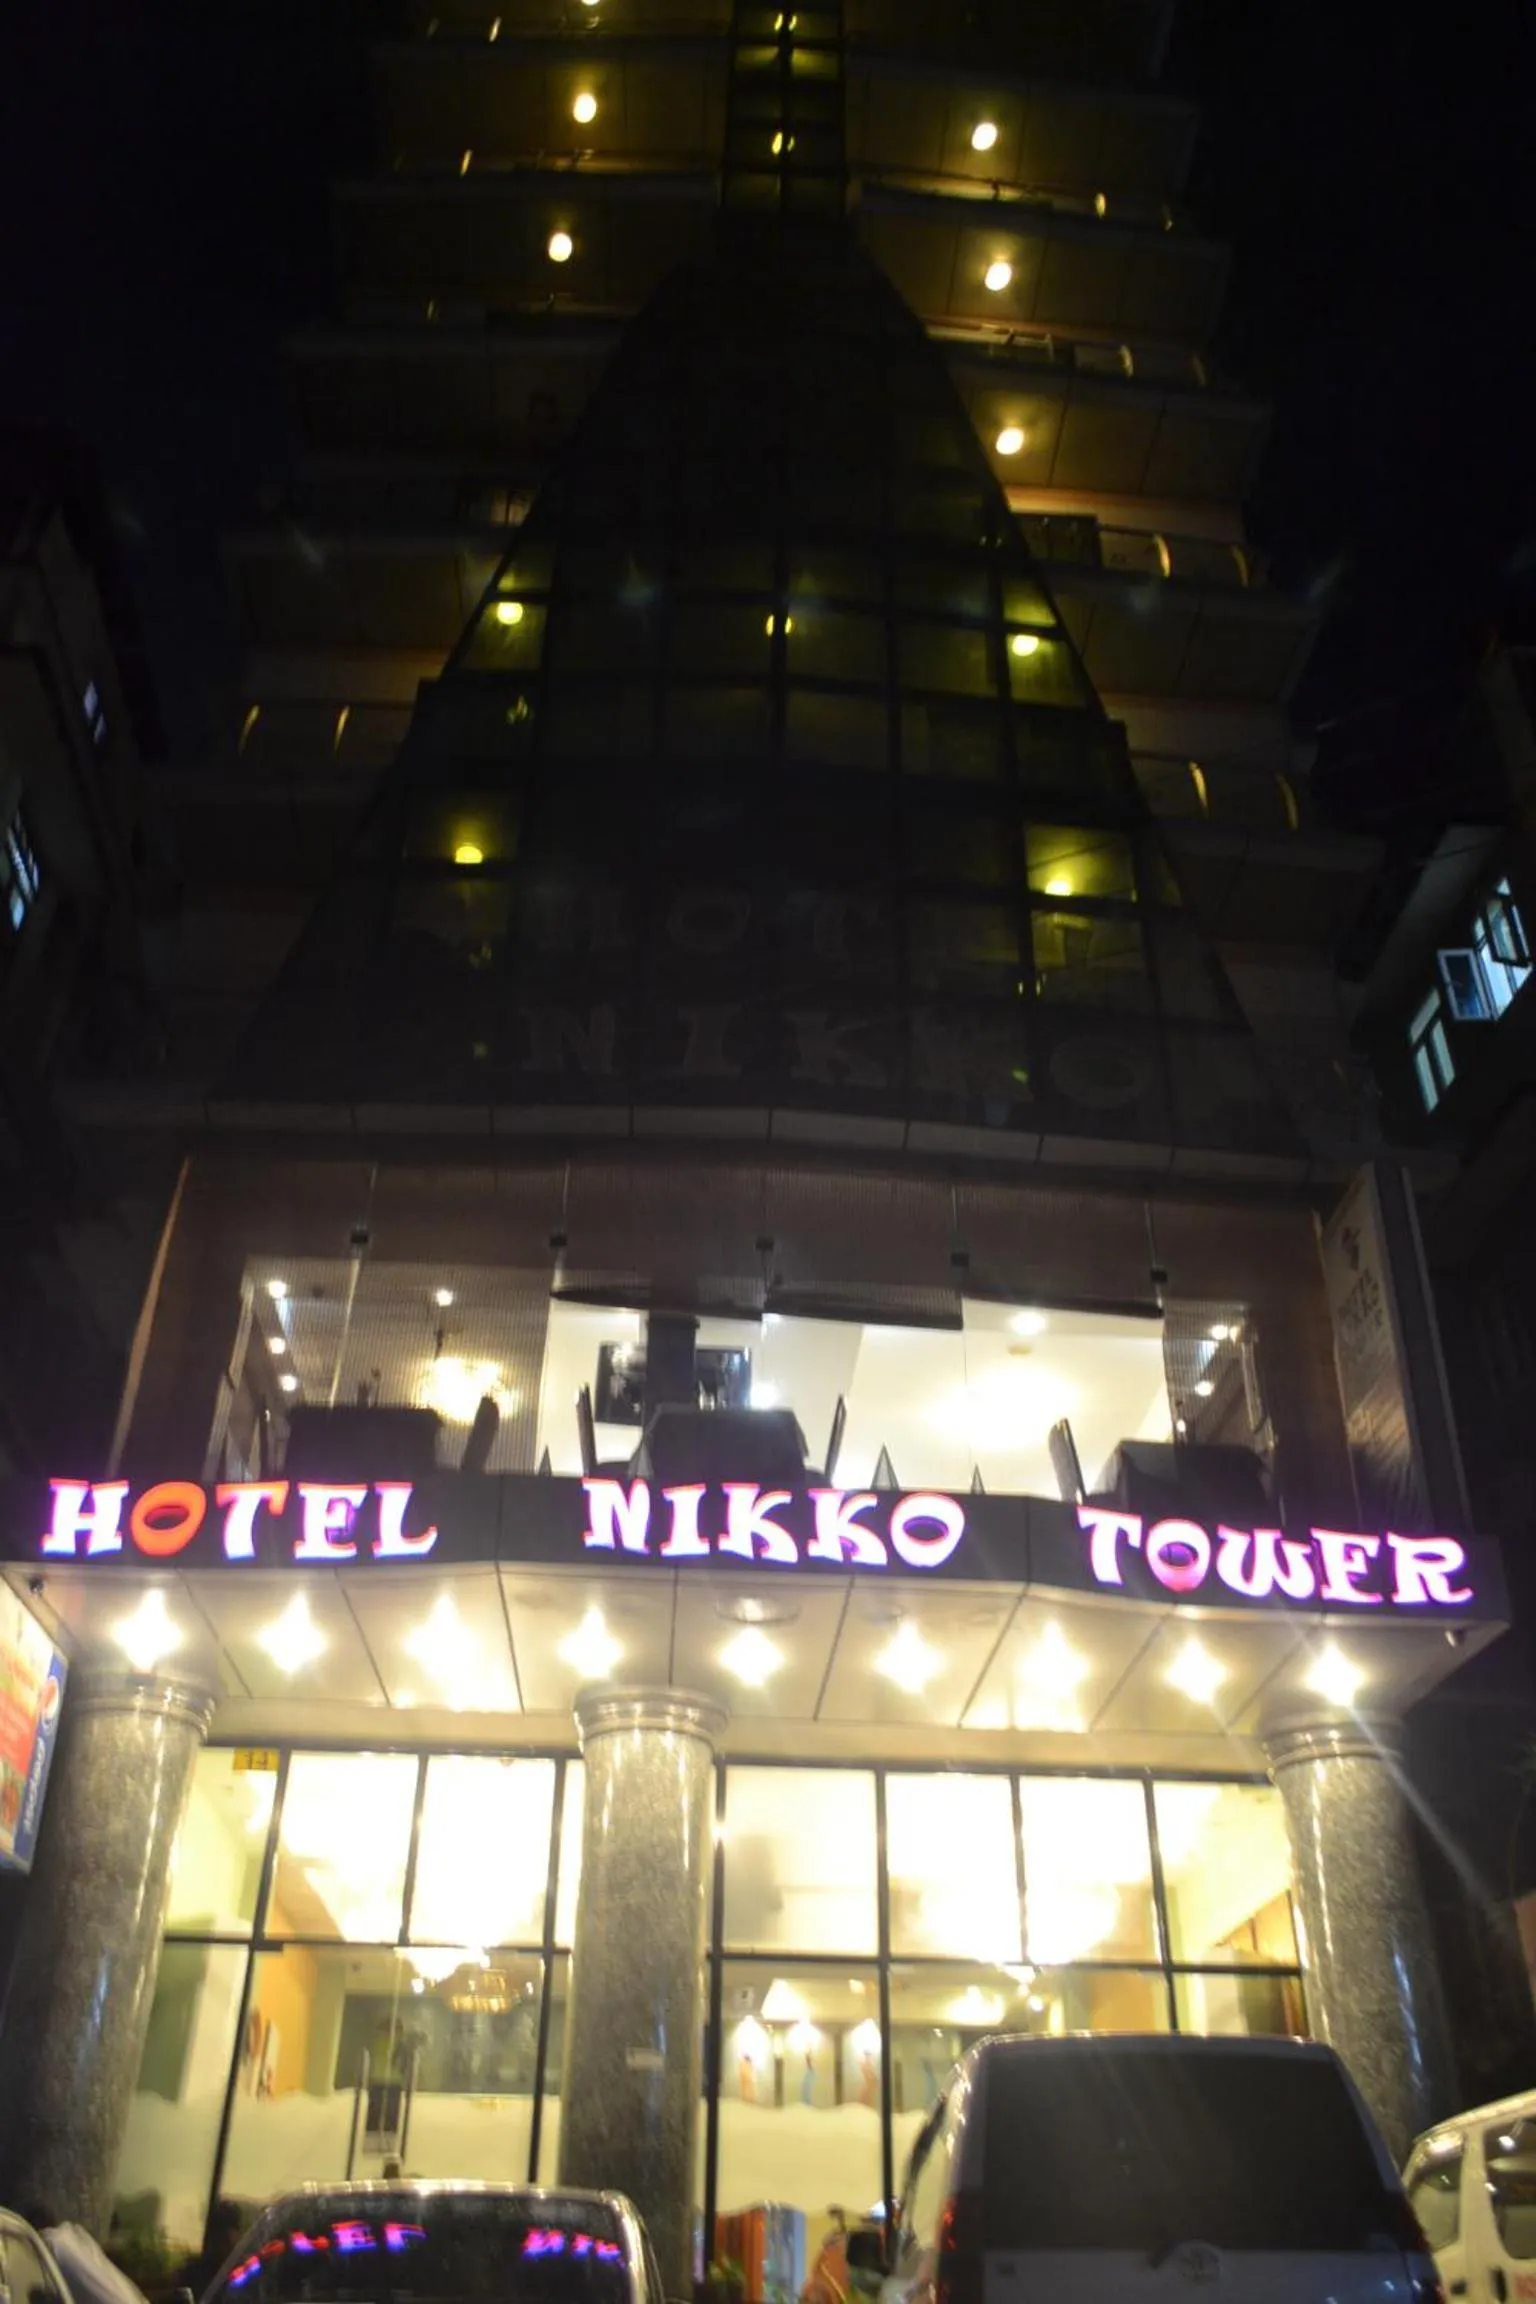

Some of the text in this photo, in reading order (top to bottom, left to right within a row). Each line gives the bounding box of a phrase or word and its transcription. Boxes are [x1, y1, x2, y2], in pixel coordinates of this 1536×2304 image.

[41, 1477, 1474, 1605] HOTEL NIKKO TOWER
